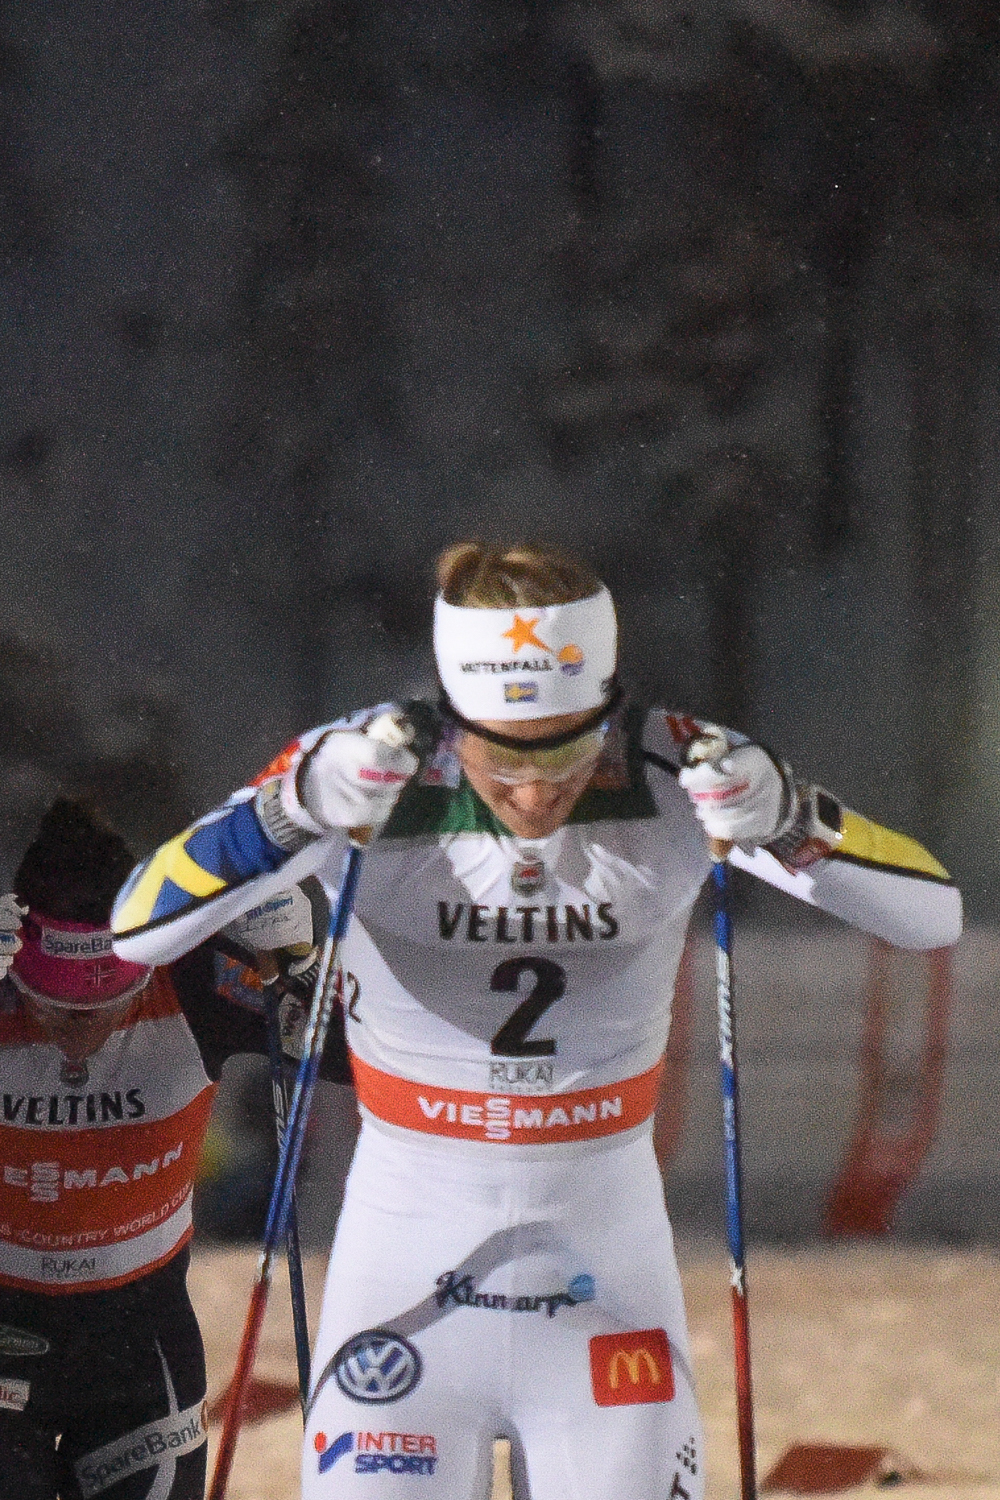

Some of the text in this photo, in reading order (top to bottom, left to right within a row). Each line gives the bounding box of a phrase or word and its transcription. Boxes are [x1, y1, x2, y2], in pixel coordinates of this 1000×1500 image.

[437, 900, 620, 943] VELTINS
[490, 955, 567, 1057] 2
[3, 1088, 146, 1126] VELTINS
[417, 1095, 624, 1141] VIESSMANN
[113, 1203, 170, 1237] WORLD
[80, 1418, 201, 1488] SpareBank
[356, 1431, 437, 1453] INTER
[354, 1453, 438, 1476] SPORT
